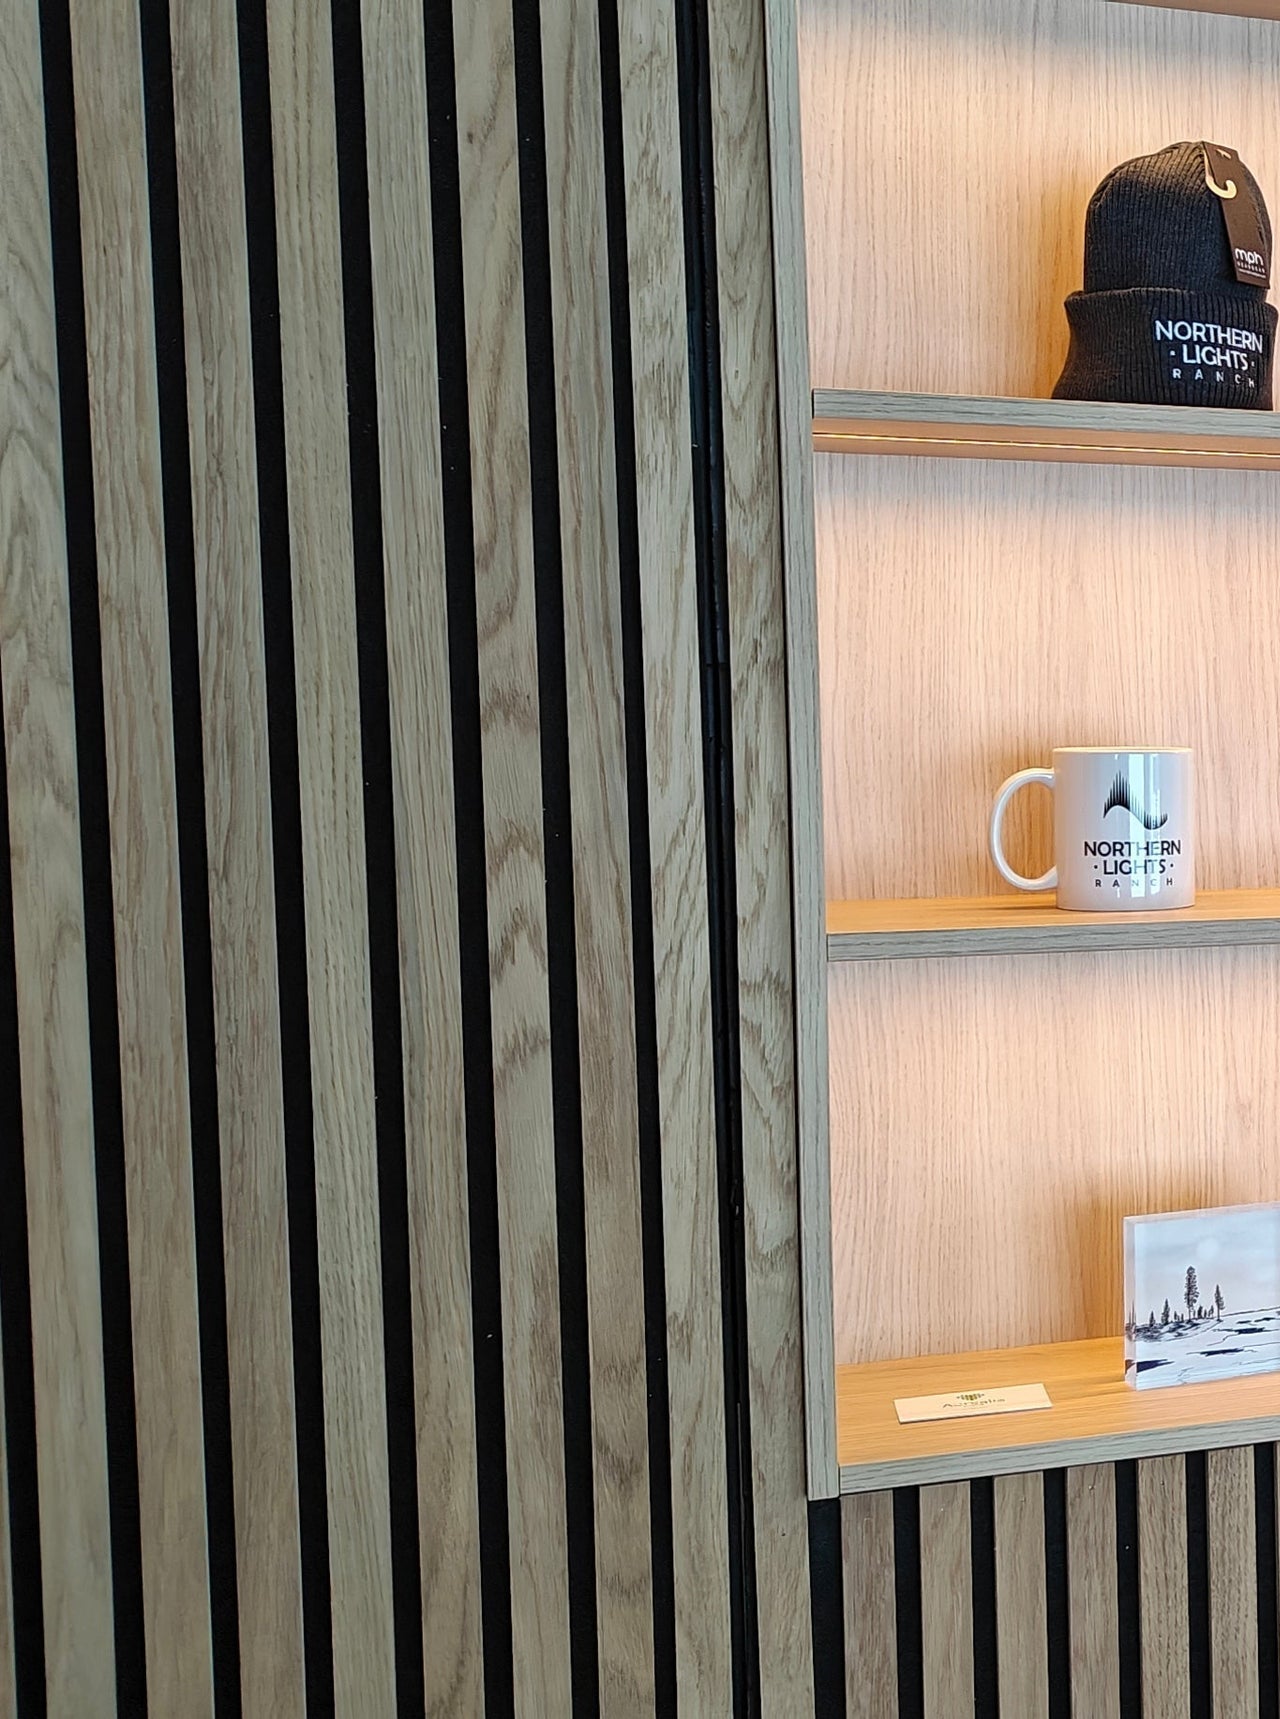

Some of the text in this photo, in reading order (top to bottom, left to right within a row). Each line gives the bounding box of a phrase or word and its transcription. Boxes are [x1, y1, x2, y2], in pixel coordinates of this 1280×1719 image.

[1234, 247, 1264, 266] mph
[1154, 319, 1263, 354] NORTHERN
[1182, 343, 1249, 371] LIGHTS
[1172, 368, 1255, 388] RANCH
[1083, 839, 1182, 857] NORTHERN
[1103, 859, 1167, 876] LIGHTS
[1094, 877, 1173, 888] RANCH
